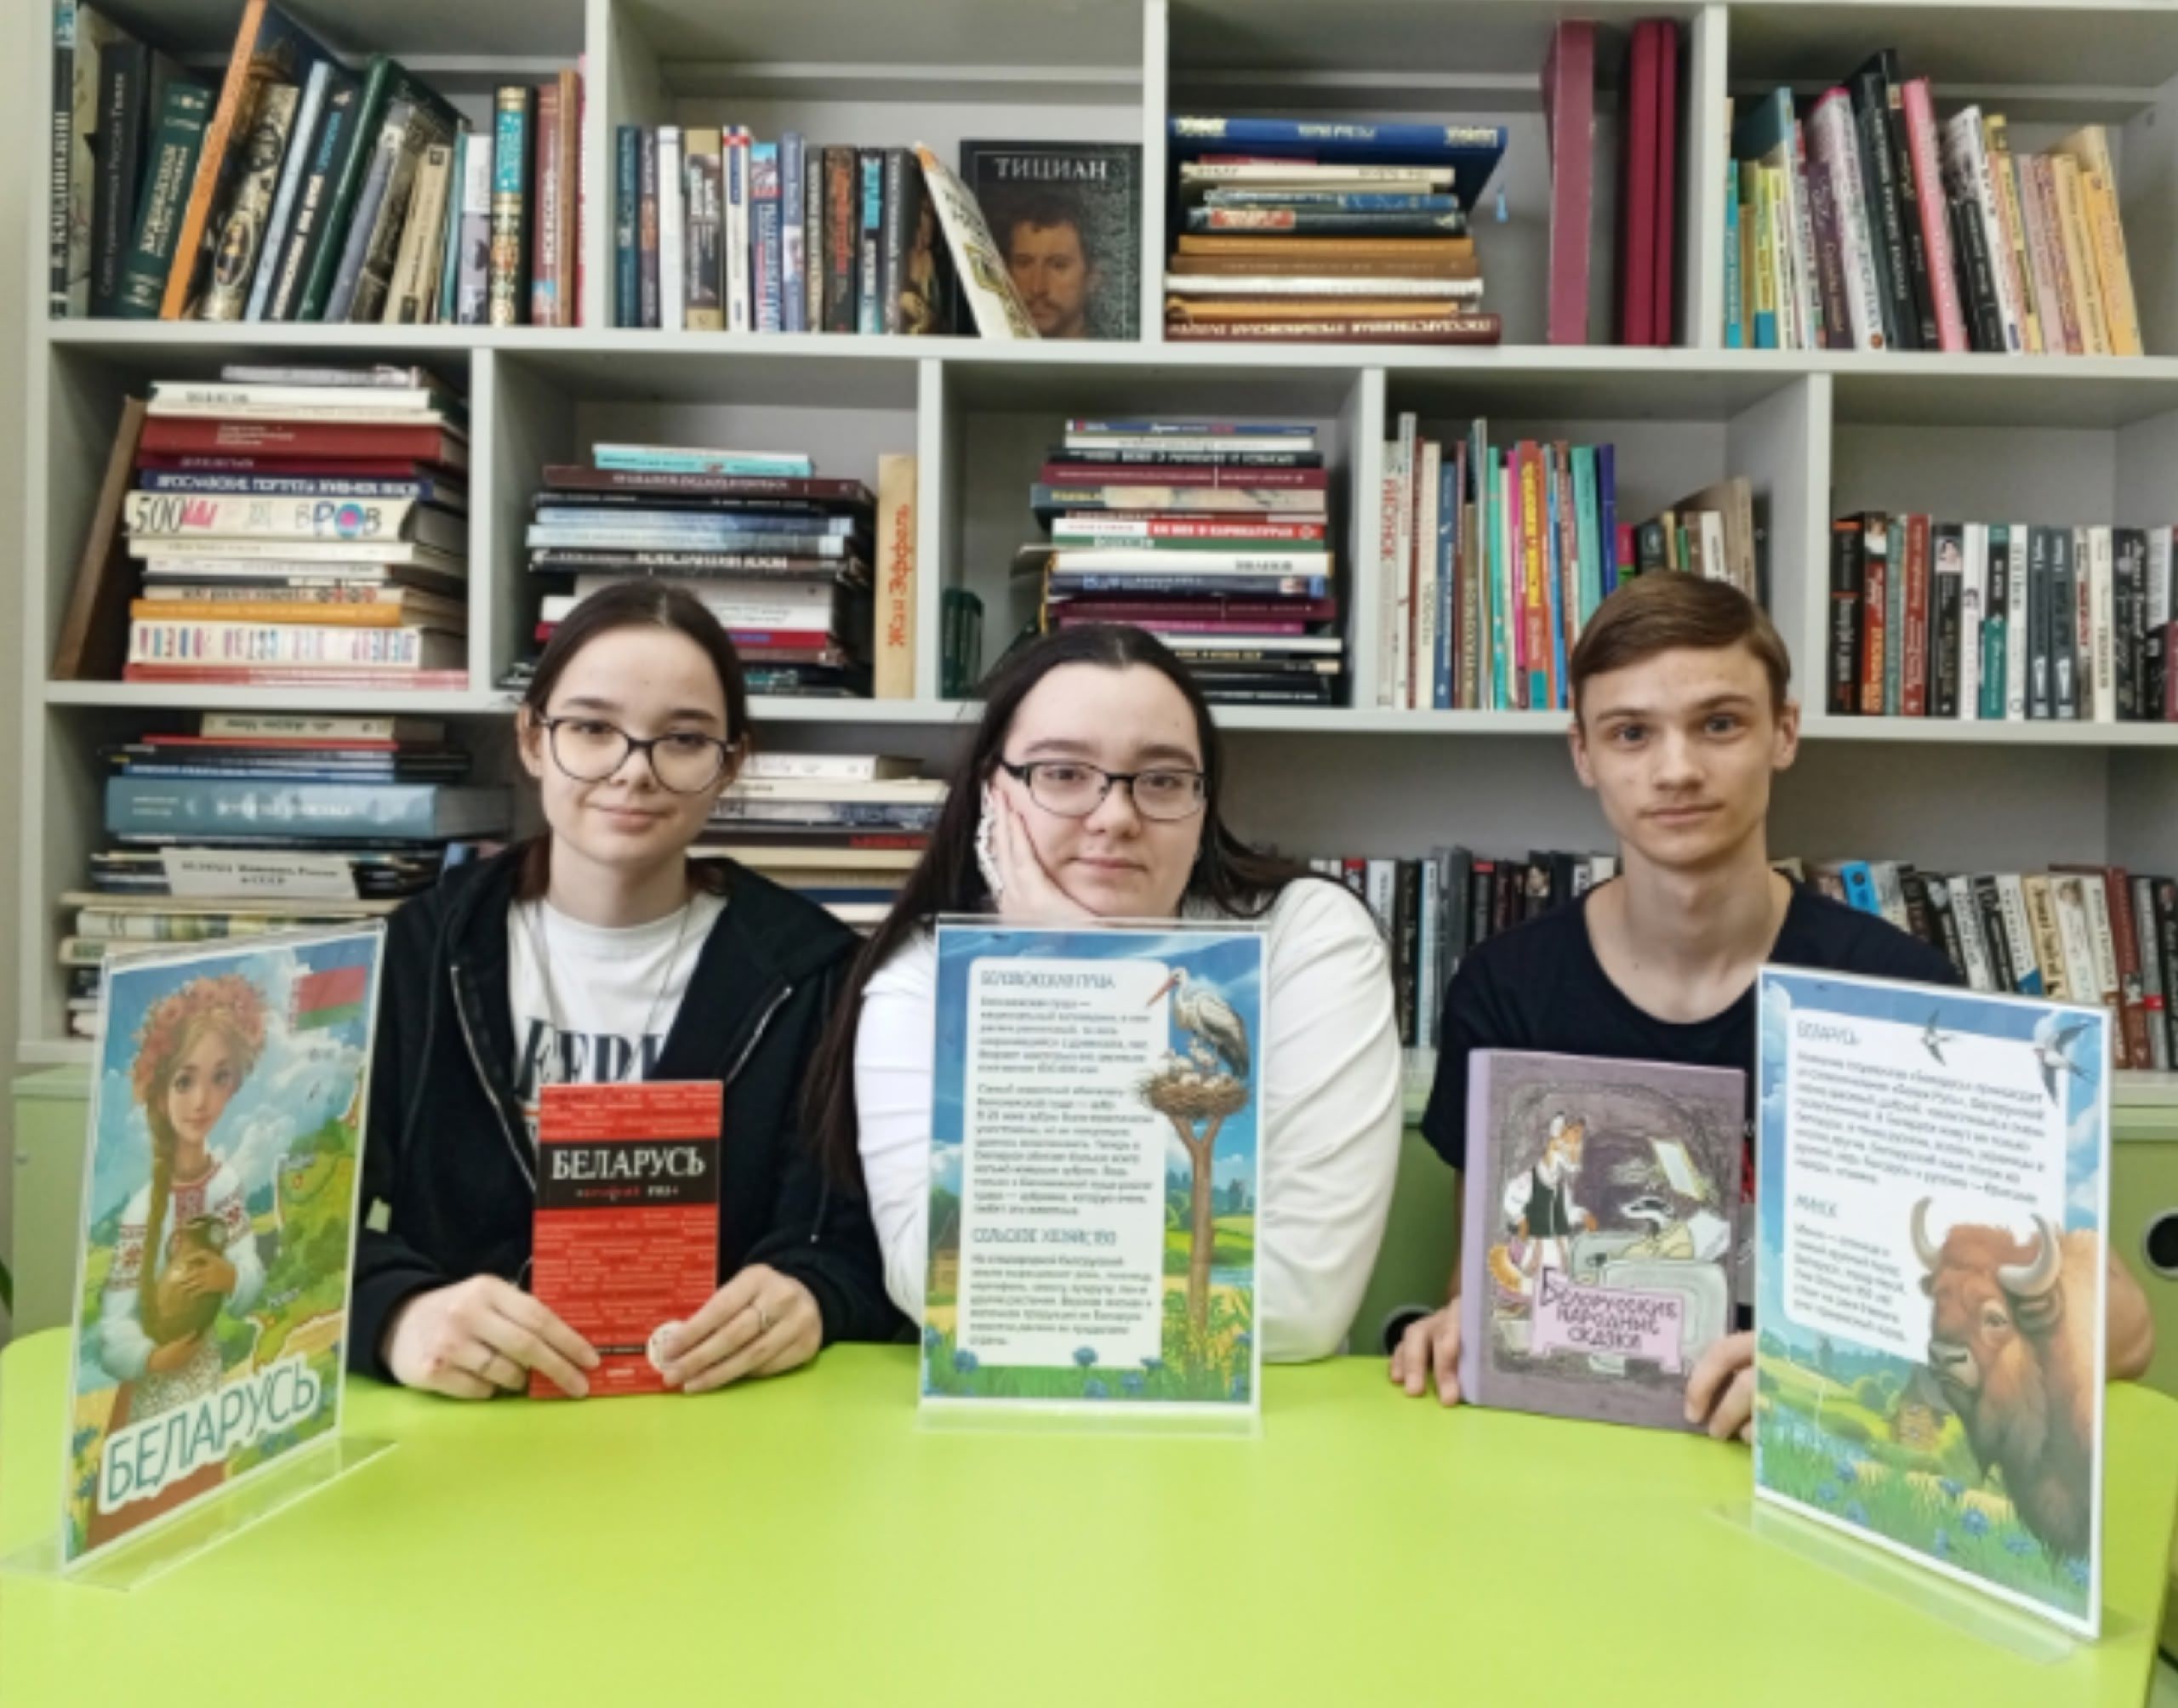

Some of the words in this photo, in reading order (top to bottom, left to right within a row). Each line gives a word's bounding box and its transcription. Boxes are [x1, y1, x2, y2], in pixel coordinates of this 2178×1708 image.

[994, 157, 1107, 181] ТИЦИАН
[134, 496, 185, 533] 500
[551, 1147, 706, 1180] БЕЛАРУСЬ
[105, 1366, 316, 1504] БЕЛАРУСЬ
